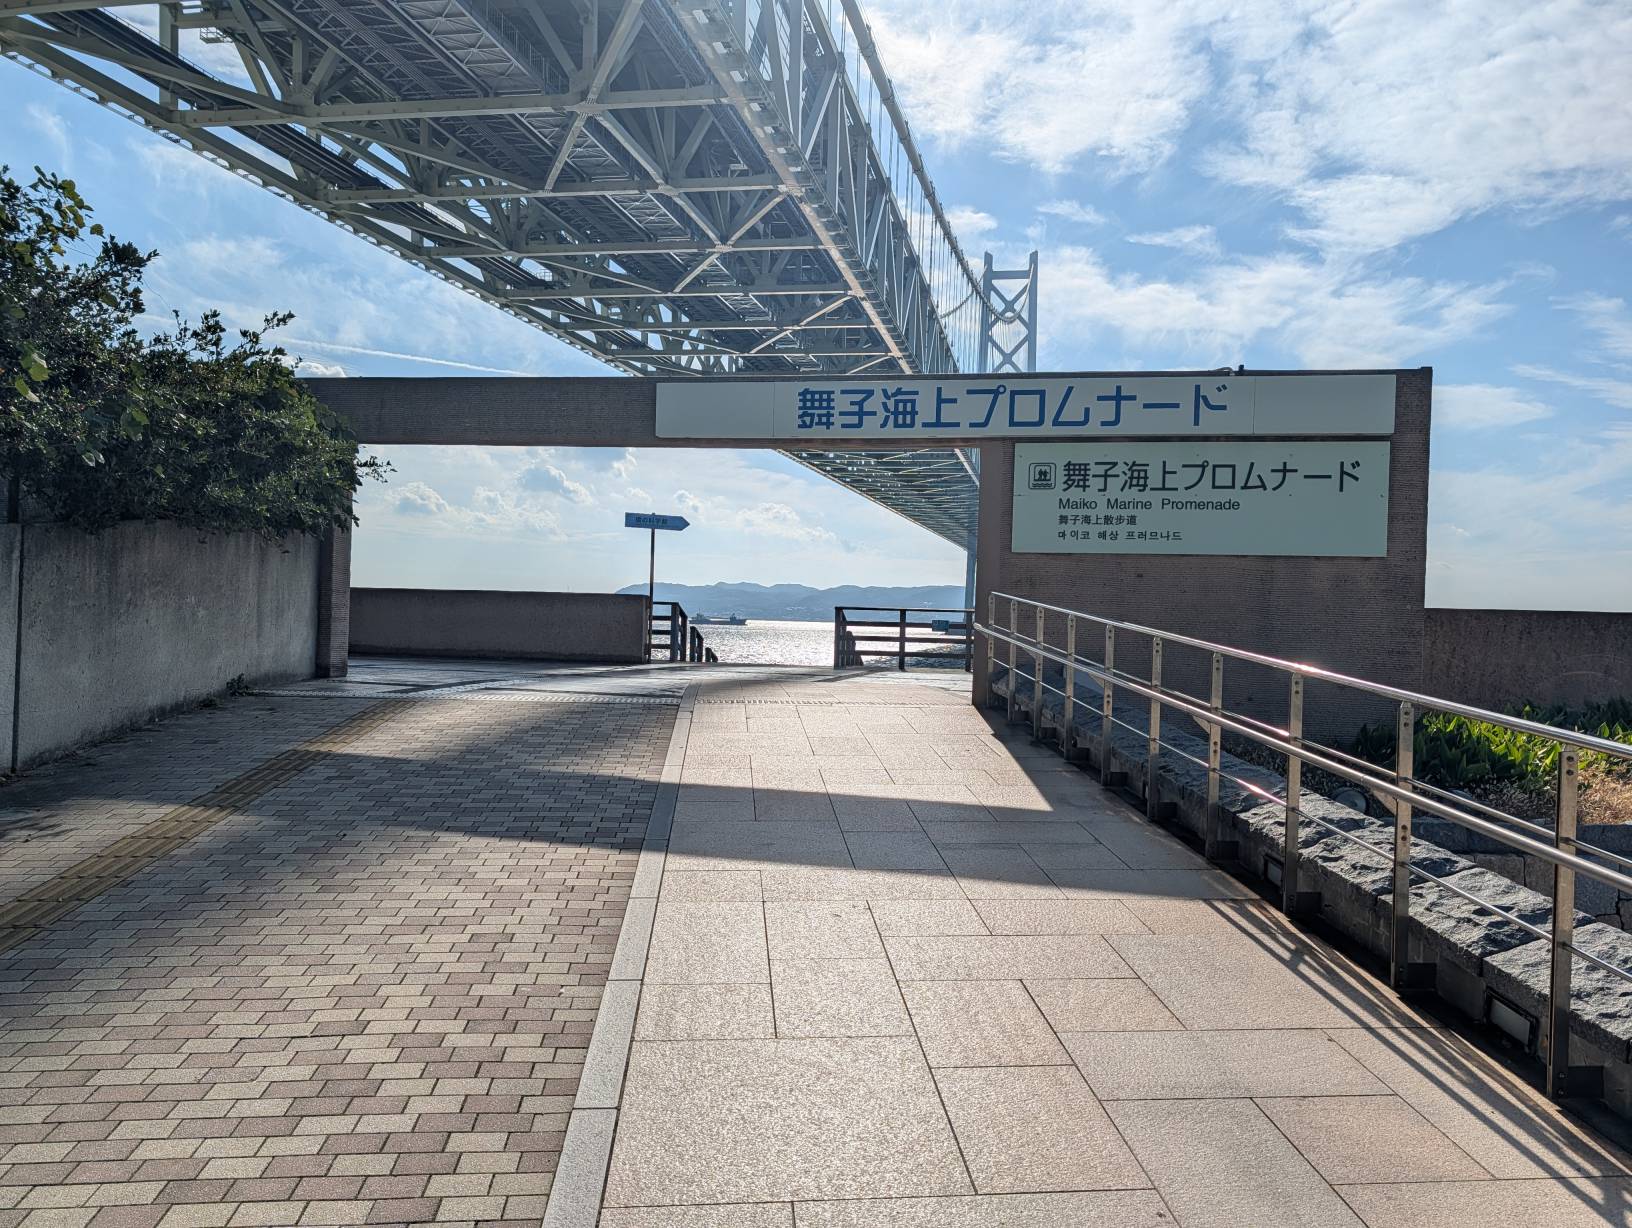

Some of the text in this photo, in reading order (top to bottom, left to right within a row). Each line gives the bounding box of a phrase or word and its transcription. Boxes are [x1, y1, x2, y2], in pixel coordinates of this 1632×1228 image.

[798, 384, 1229, 430] 舞子海上プロムナード
[1062, 460, 1361, 493] 舞子海上プロムナード
[1058, 497, 1241, 511] Maiko Marine Promenade
[1057, 529, 1091, 541] 마이코
[1097, 529, 1119, 541] 해상
